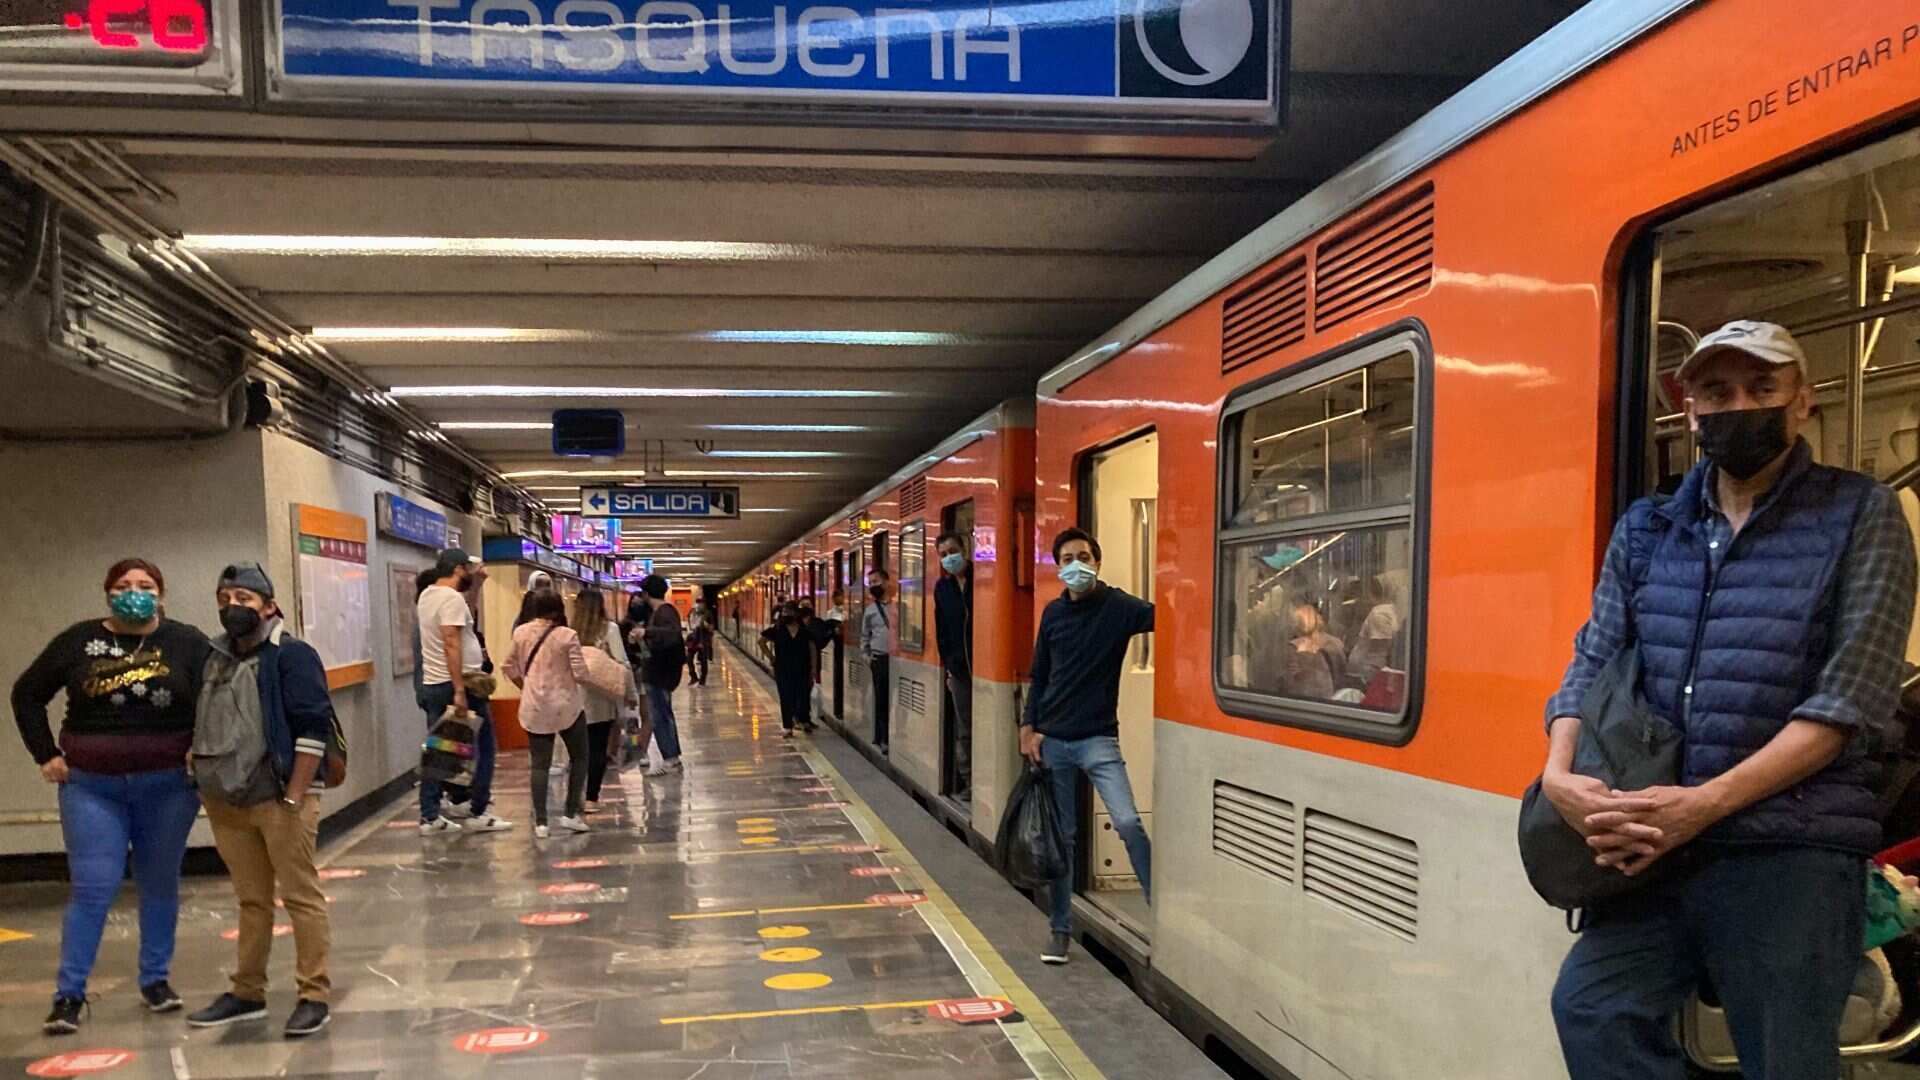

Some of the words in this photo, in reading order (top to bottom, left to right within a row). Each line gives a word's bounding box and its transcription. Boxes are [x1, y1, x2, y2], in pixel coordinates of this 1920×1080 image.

[1671, 110, 1740, 158] ANTES
[1748, 91, 1779, 123] DE
[1786, 37, 1892, 105] ENTRAR
[614, 493, 705, 511] SALIDA
